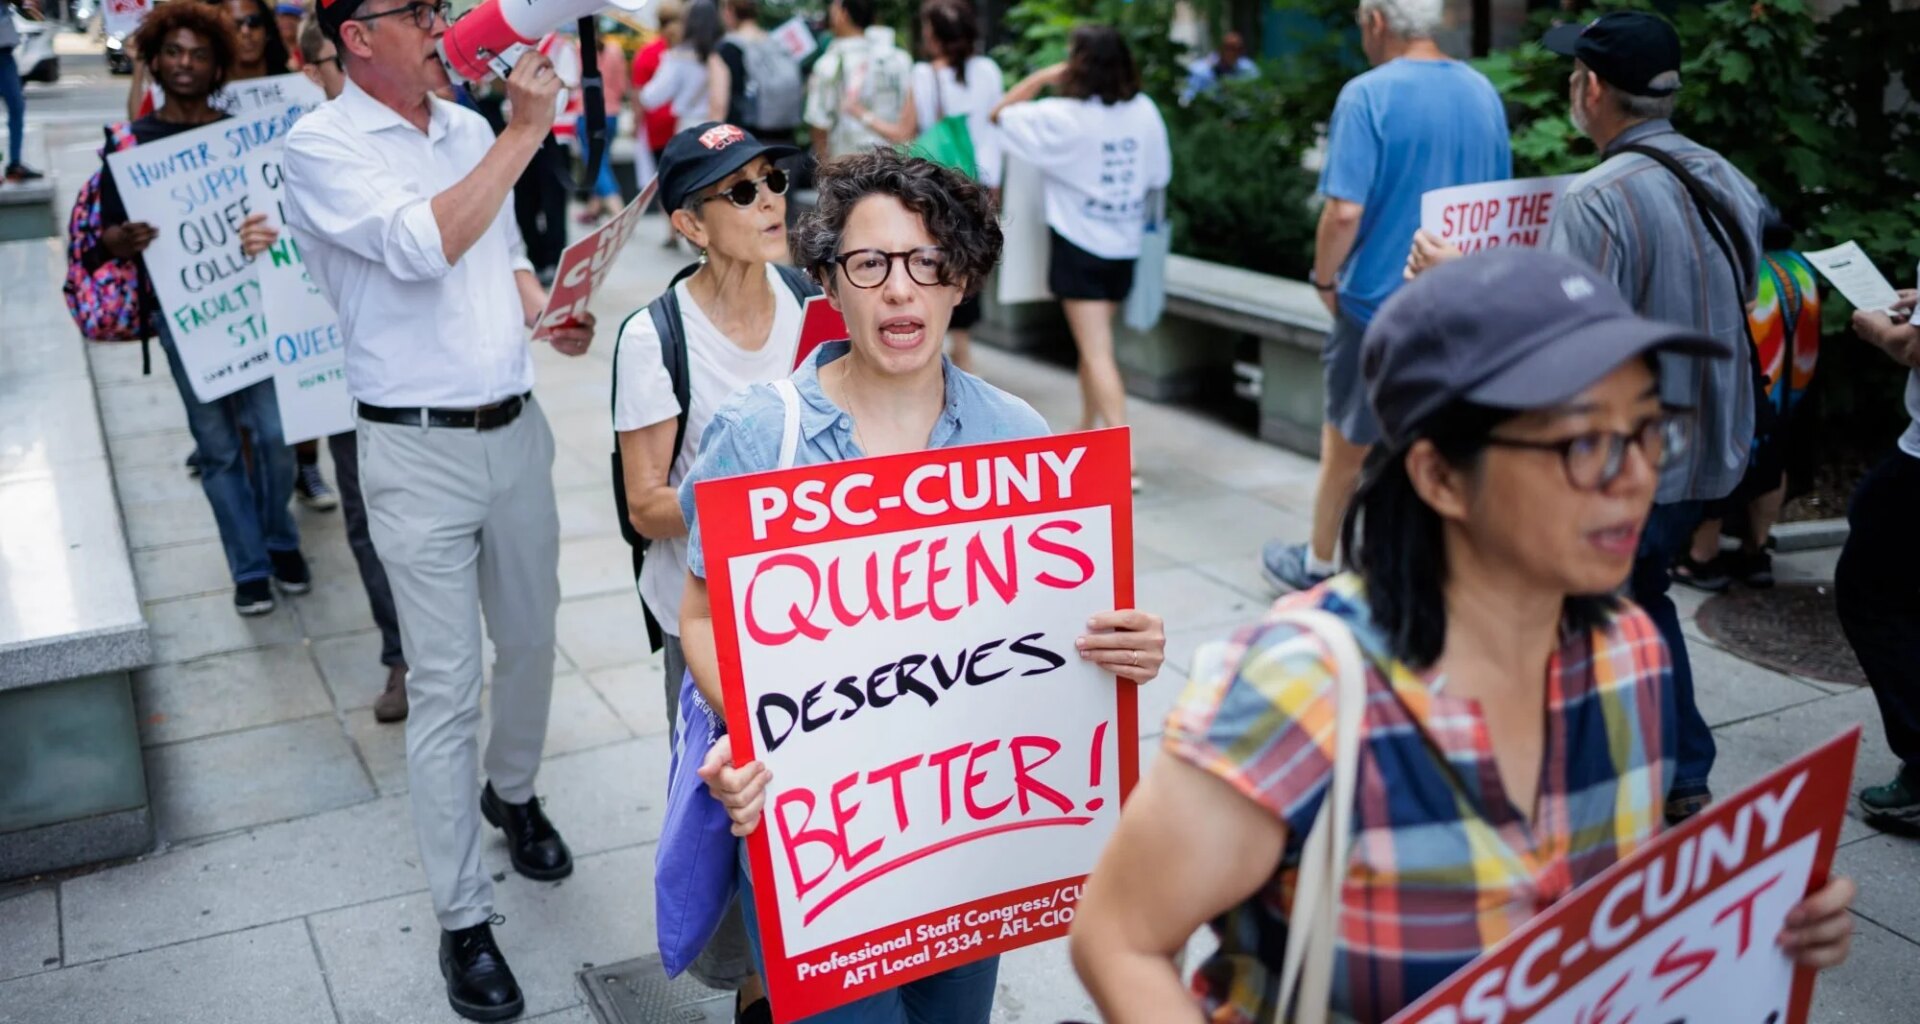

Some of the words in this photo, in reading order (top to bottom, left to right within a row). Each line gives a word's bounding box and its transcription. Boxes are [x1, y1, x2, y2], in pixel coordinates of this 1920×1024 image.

[128, 142, 218, 188] HUNTER
[698, 123, 744, 149] PSC
[1442, 199, 1500, 237] STOP
[1507, 191, 1554, 228] THE
[173, 278, 262, 335] FACULTY
[748, 446, 1088, 541] PSC-CUNY
[744, 520, 1095, 646] QUEENS
[756, 632, 1066, 752] DESERVES
[774, 721, 1108, 902] BETTER!
[797, 929, 912, 981] Professional
[916, 913, 961, 943] Staff
[843, 962, 878, 989] AFT
[882, 945, 930, 975] Local
[934, 930, 983, 959] 2334
[999, 907, 1074, 939] AFL-CIO
